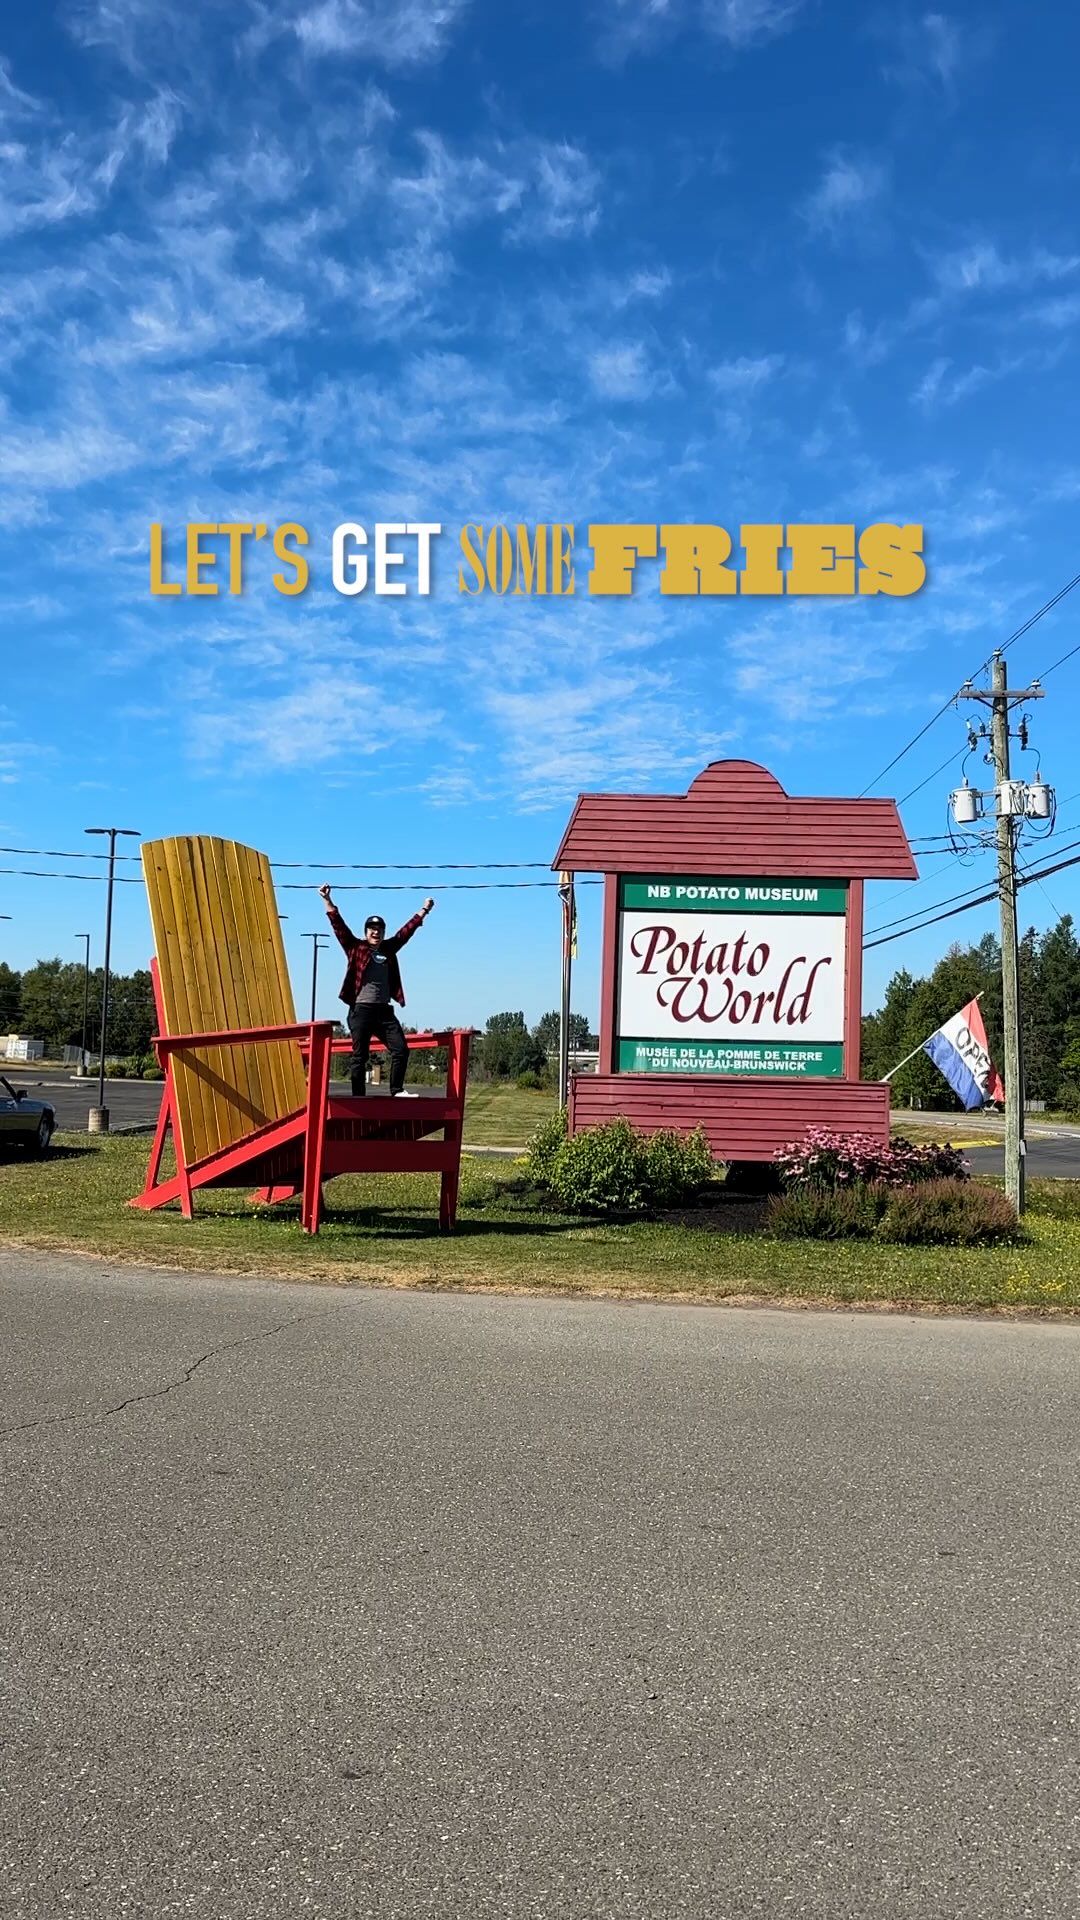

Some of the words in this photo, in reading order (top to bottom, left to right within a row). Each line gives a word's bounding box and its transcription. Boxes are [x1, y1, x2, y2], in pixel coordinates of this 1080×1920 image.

[647, 885, 671, 898] NB
[676, 886, 740, 900] POTATO
[745, 888, 818, 901] MUSEUM
[630, 926, 770, 977] Potato
[656, 956, 832, 1025] World
[636, 1046, 677, 1057] MUSÉE
[680, 1049, 696, 1058] DE
[699, 1049, 714, 1058] LA
[718, 1050, 761, 1060] POMME
[764, 1051, 780, 1060] DE
[783, 1051, 823, 1061] TERRE
[652, 1058, 669, 1067] DU
[672, 1059, 806, 1071] NOUVEAU-BRUNSWICK
